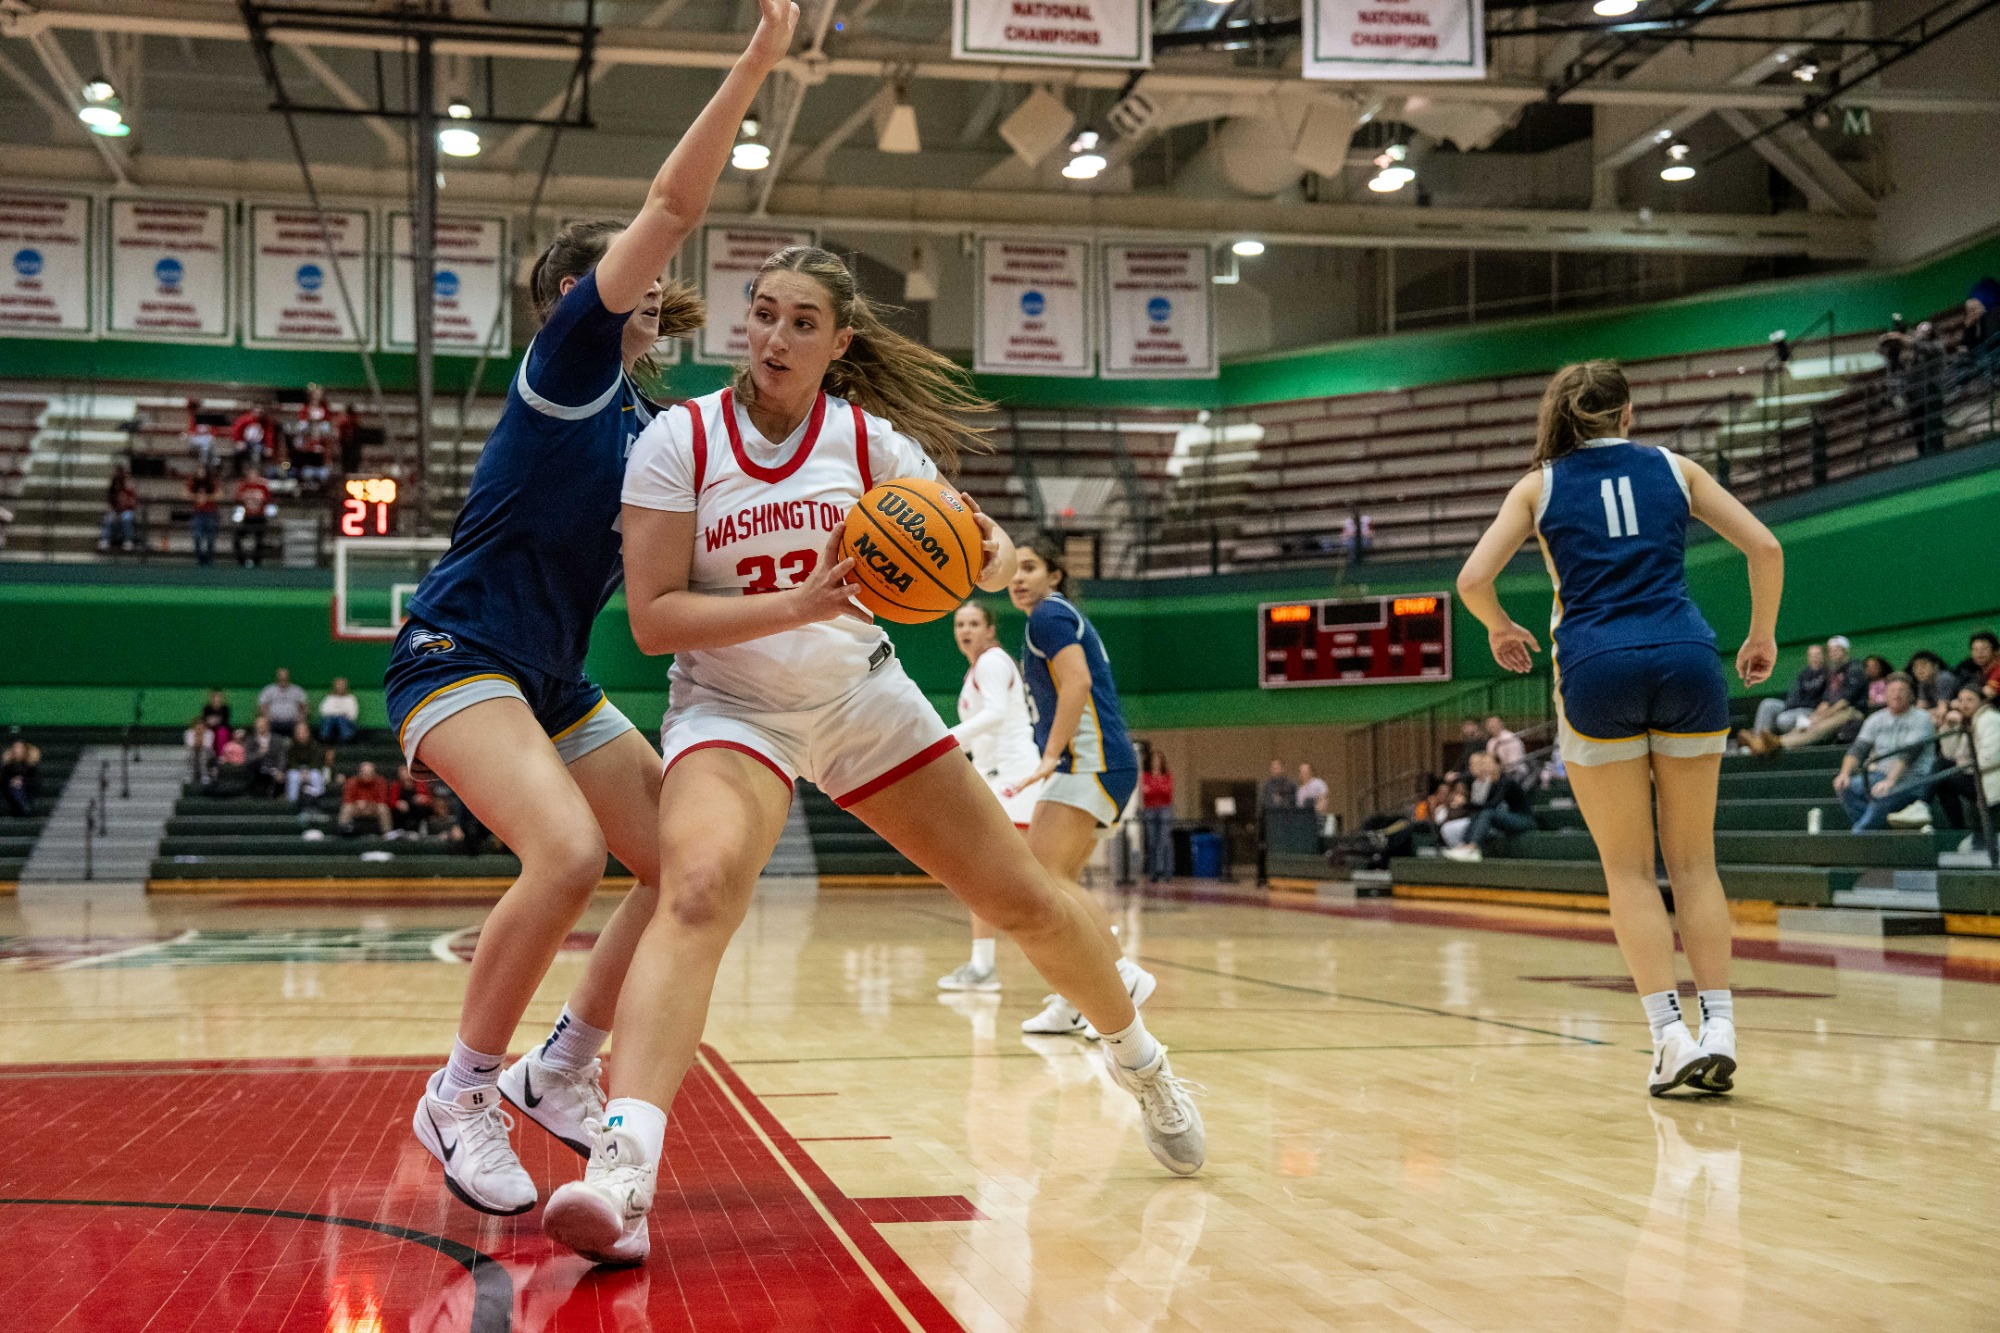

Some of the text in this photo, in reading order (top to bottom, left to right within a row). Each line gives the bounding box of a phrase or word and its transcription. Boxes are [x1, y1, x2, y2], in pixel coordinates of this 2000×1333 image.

[1012, 2, 1093, 21] NATIONAL
[1357, 10, 1431, 26] NATIONAL
[1003, 25, 1101, 46] CHAMPIONS
[1350, 31, 1439, 49] CHAMPIONS
[342, 499, 388, 536] 21
[704, 500, 846, 553] WASHINGTON
[1600, 475, 1640, 538] 11
[876, 491, 950, 571] Wilson
[735, 548, 819, 596] 33
[853, 532, 915, 593] NCAA
